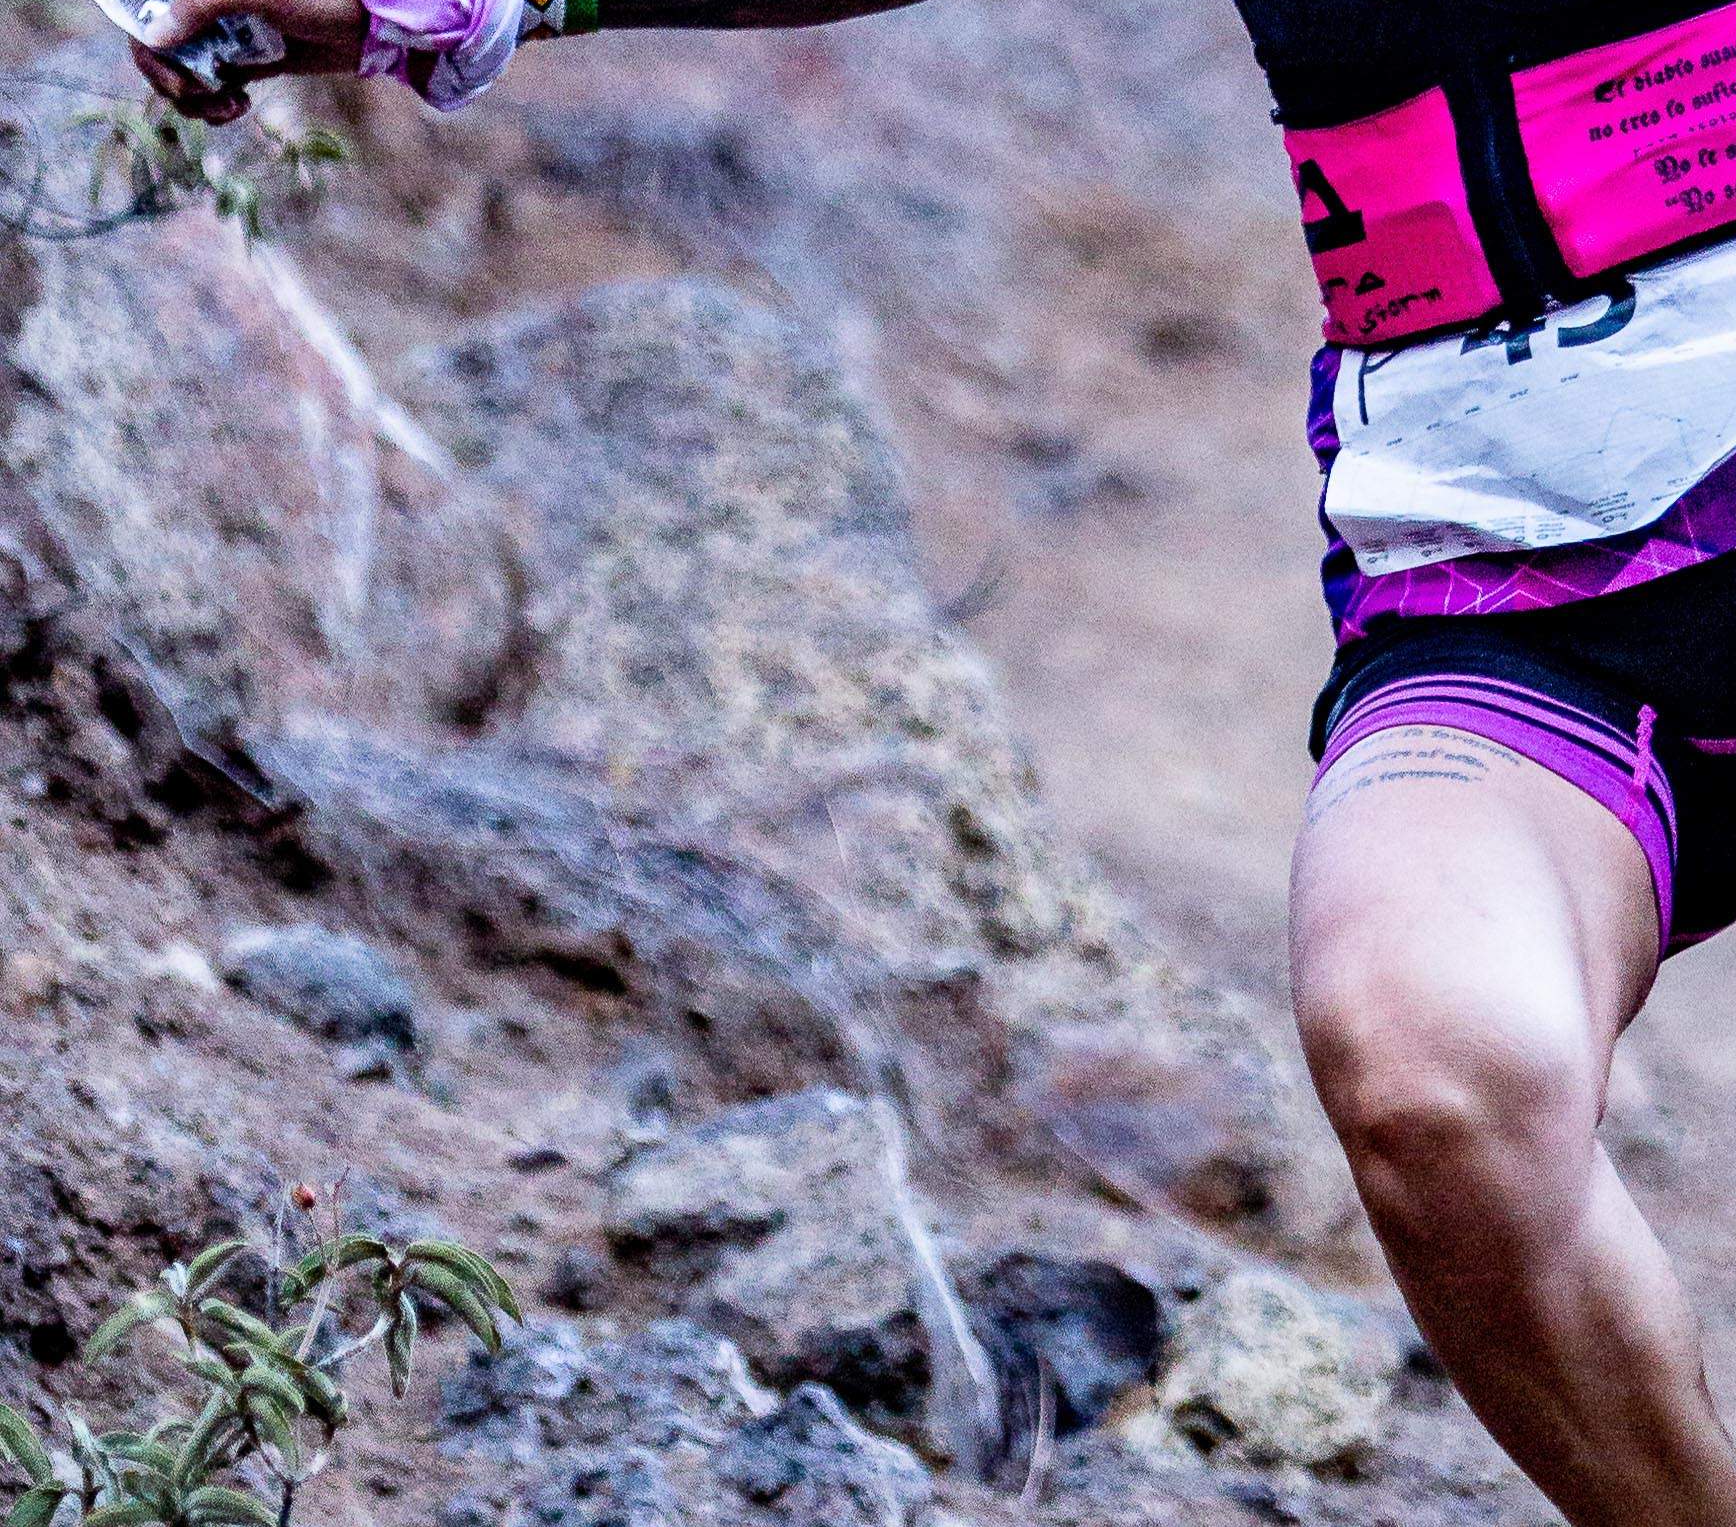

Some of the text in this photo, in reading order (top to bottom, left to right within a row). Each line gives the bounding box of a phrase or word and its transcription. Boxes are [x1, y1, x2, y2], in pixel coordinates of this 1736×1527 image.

[1633, 58, 1694, 92] diablo
[1589, 123, 1613, 142] no
[1620, 110, 1661, 135] eres
